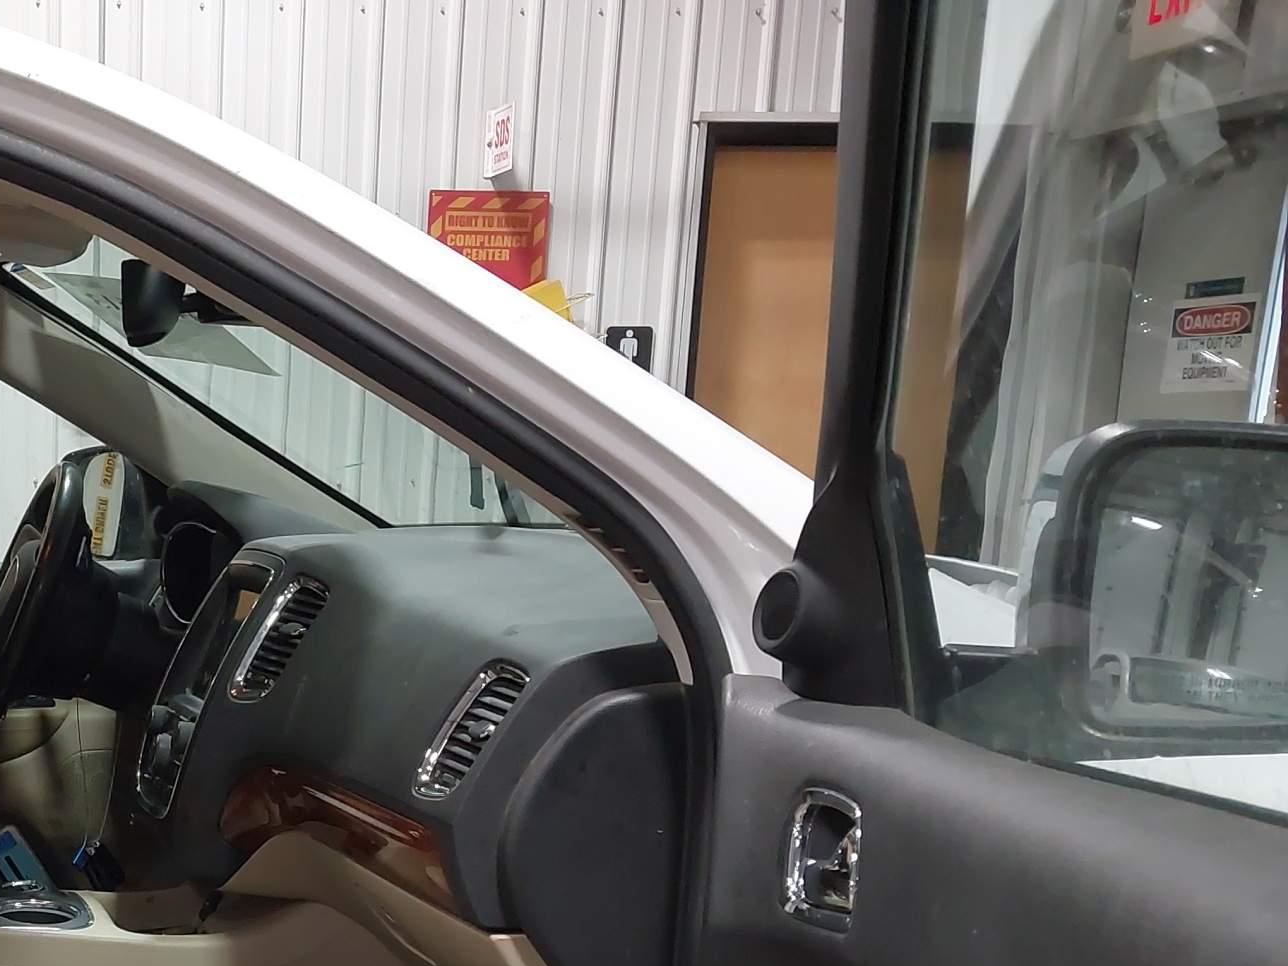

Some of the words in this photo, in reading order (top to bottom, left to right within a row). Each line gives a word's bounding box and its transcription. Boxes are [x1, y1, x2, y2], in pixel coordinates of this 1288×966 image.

[495, 115, 511, 149] SDS
[448, 215, 479, 228] RIGHT
[482, 215, 495, 228] TO
[447, 234, 529, 247] COMPLIANCE
[463, 248, 510, 261] CENTER
[1183, 311, 1242, 331] DANGER
